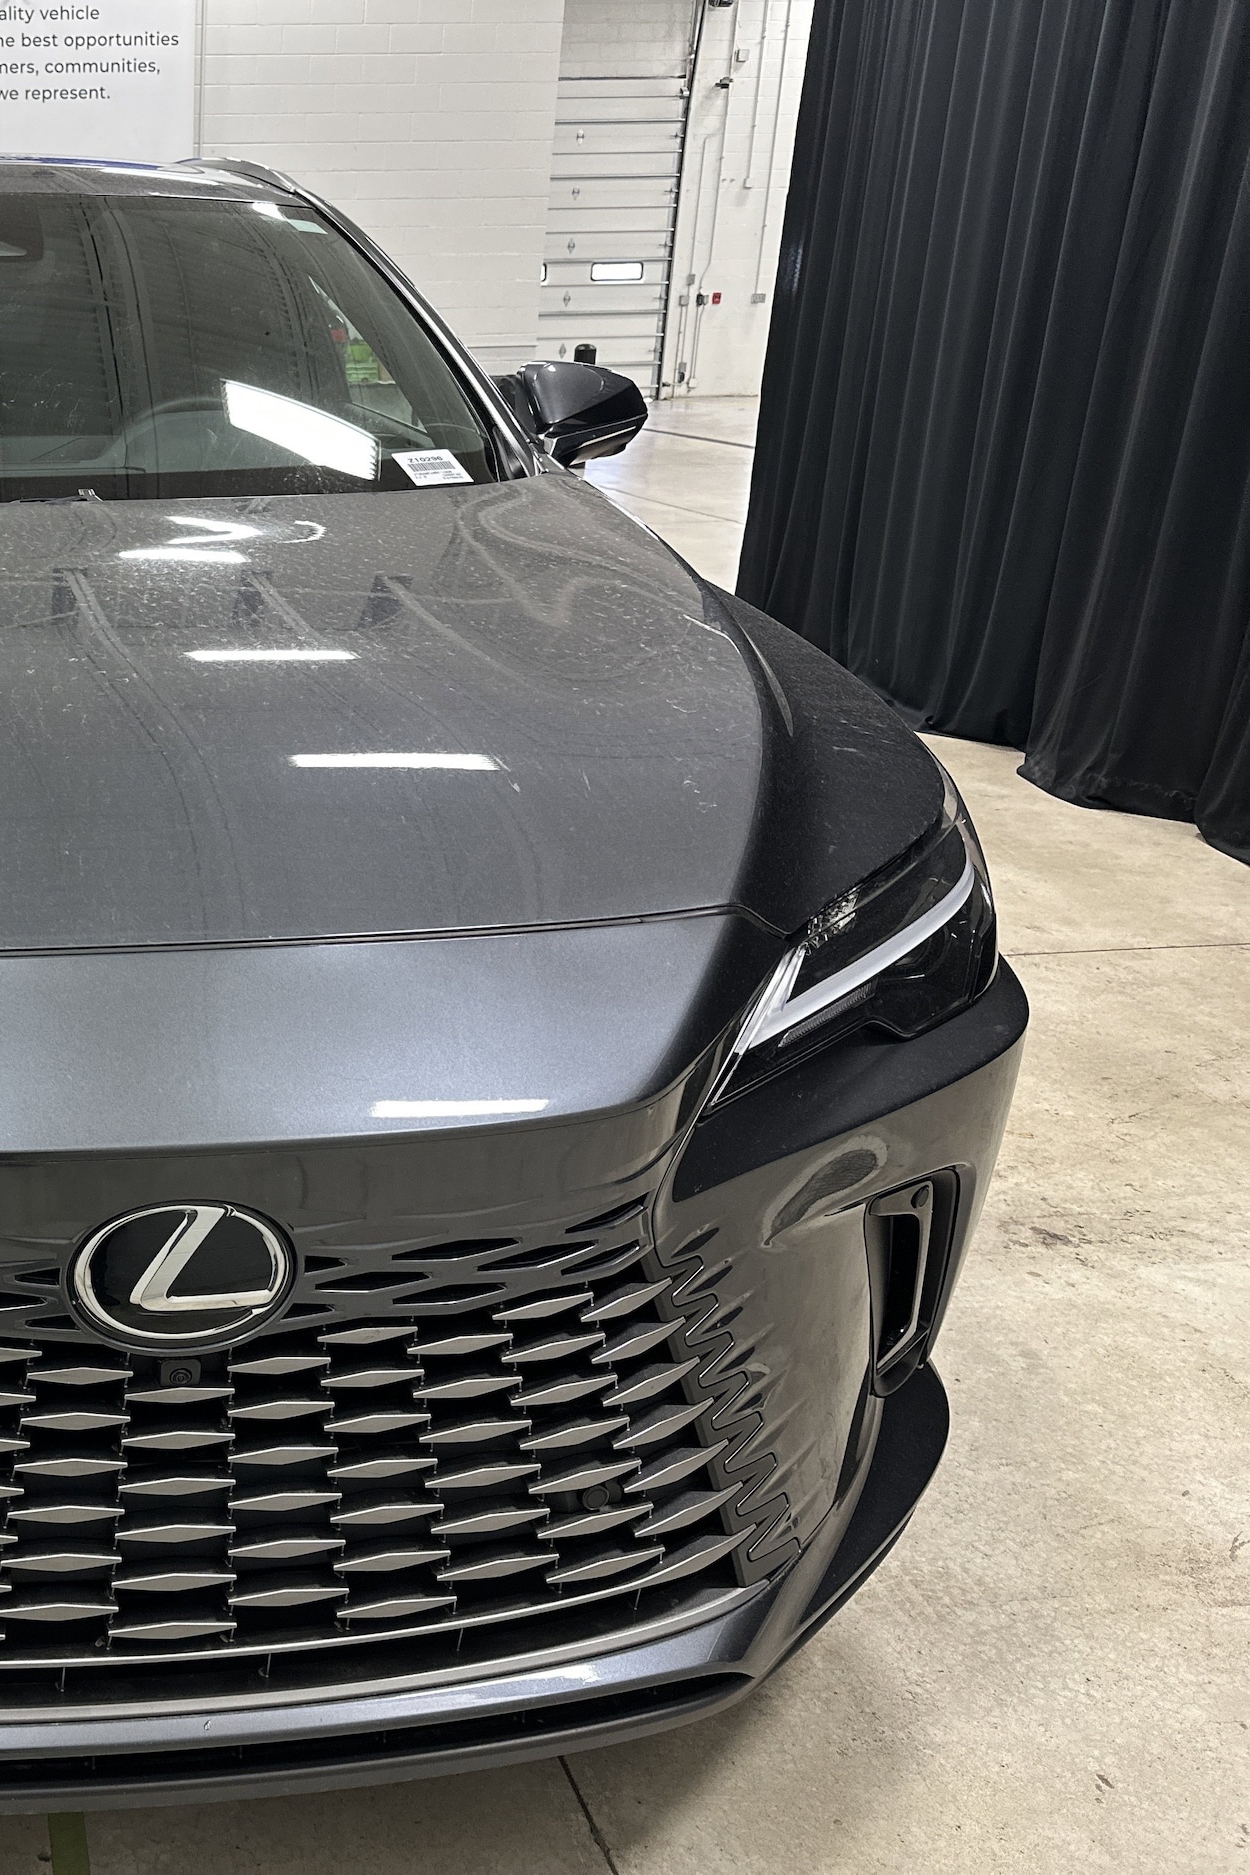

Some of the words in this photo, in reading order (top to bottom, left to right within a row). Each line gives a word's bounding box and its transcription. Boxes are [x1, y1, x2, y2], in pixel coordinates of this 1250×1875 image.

[39, 5, 100, 21] vehicle
[21, 32, 59, 48] best
[63, 30, 180, 50] opportunities
[44, 57, 161, 75] communities,
[24, 86, 111, 103] represent.
